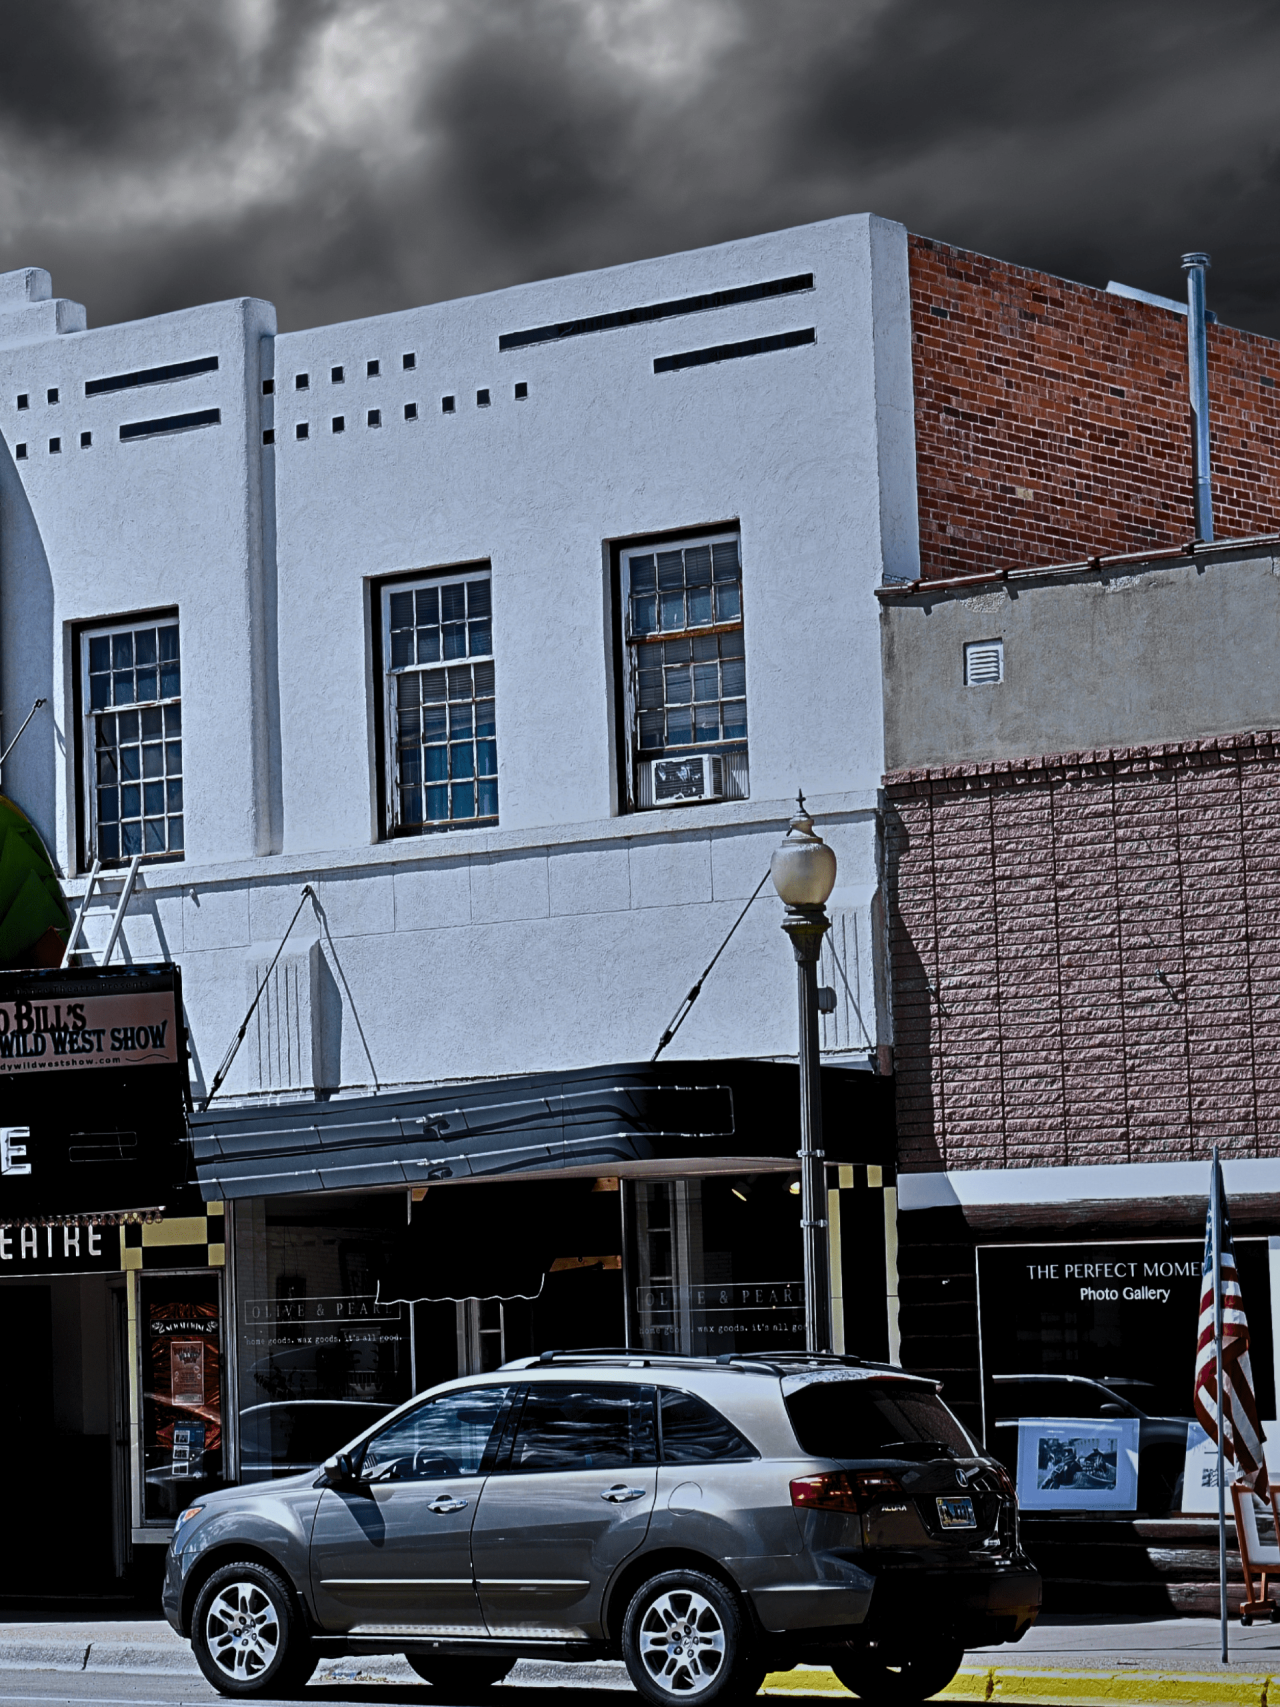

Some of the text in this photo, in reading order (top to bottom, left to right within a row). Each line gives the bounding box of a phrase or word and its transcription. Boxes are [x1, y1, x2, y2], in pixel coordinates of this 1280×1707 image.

[13, 1000, 86, 1033] BILL'S
[52, 1029, 106, 1055] WEST
[110, 1020, 169, 1051] SHOW
[1026, 1262, 1204, 1280] THE PERFECT MOME
[719, 1290, 729, 1304] &
[1080, 1286, 1171, 1304] Photo Gallery
[252, 1301, 392, 1318] OLIVE & PEARL
[718, 1323, 748, 1334] goods.
[752, 1322, 769, 1332] it's
[772, 1323, 789, 1332] all
[268, 1335, 294, 1346] goods.
[297, 1336, 312, 1344] wax
[362, 1333, 376, 1342] all
